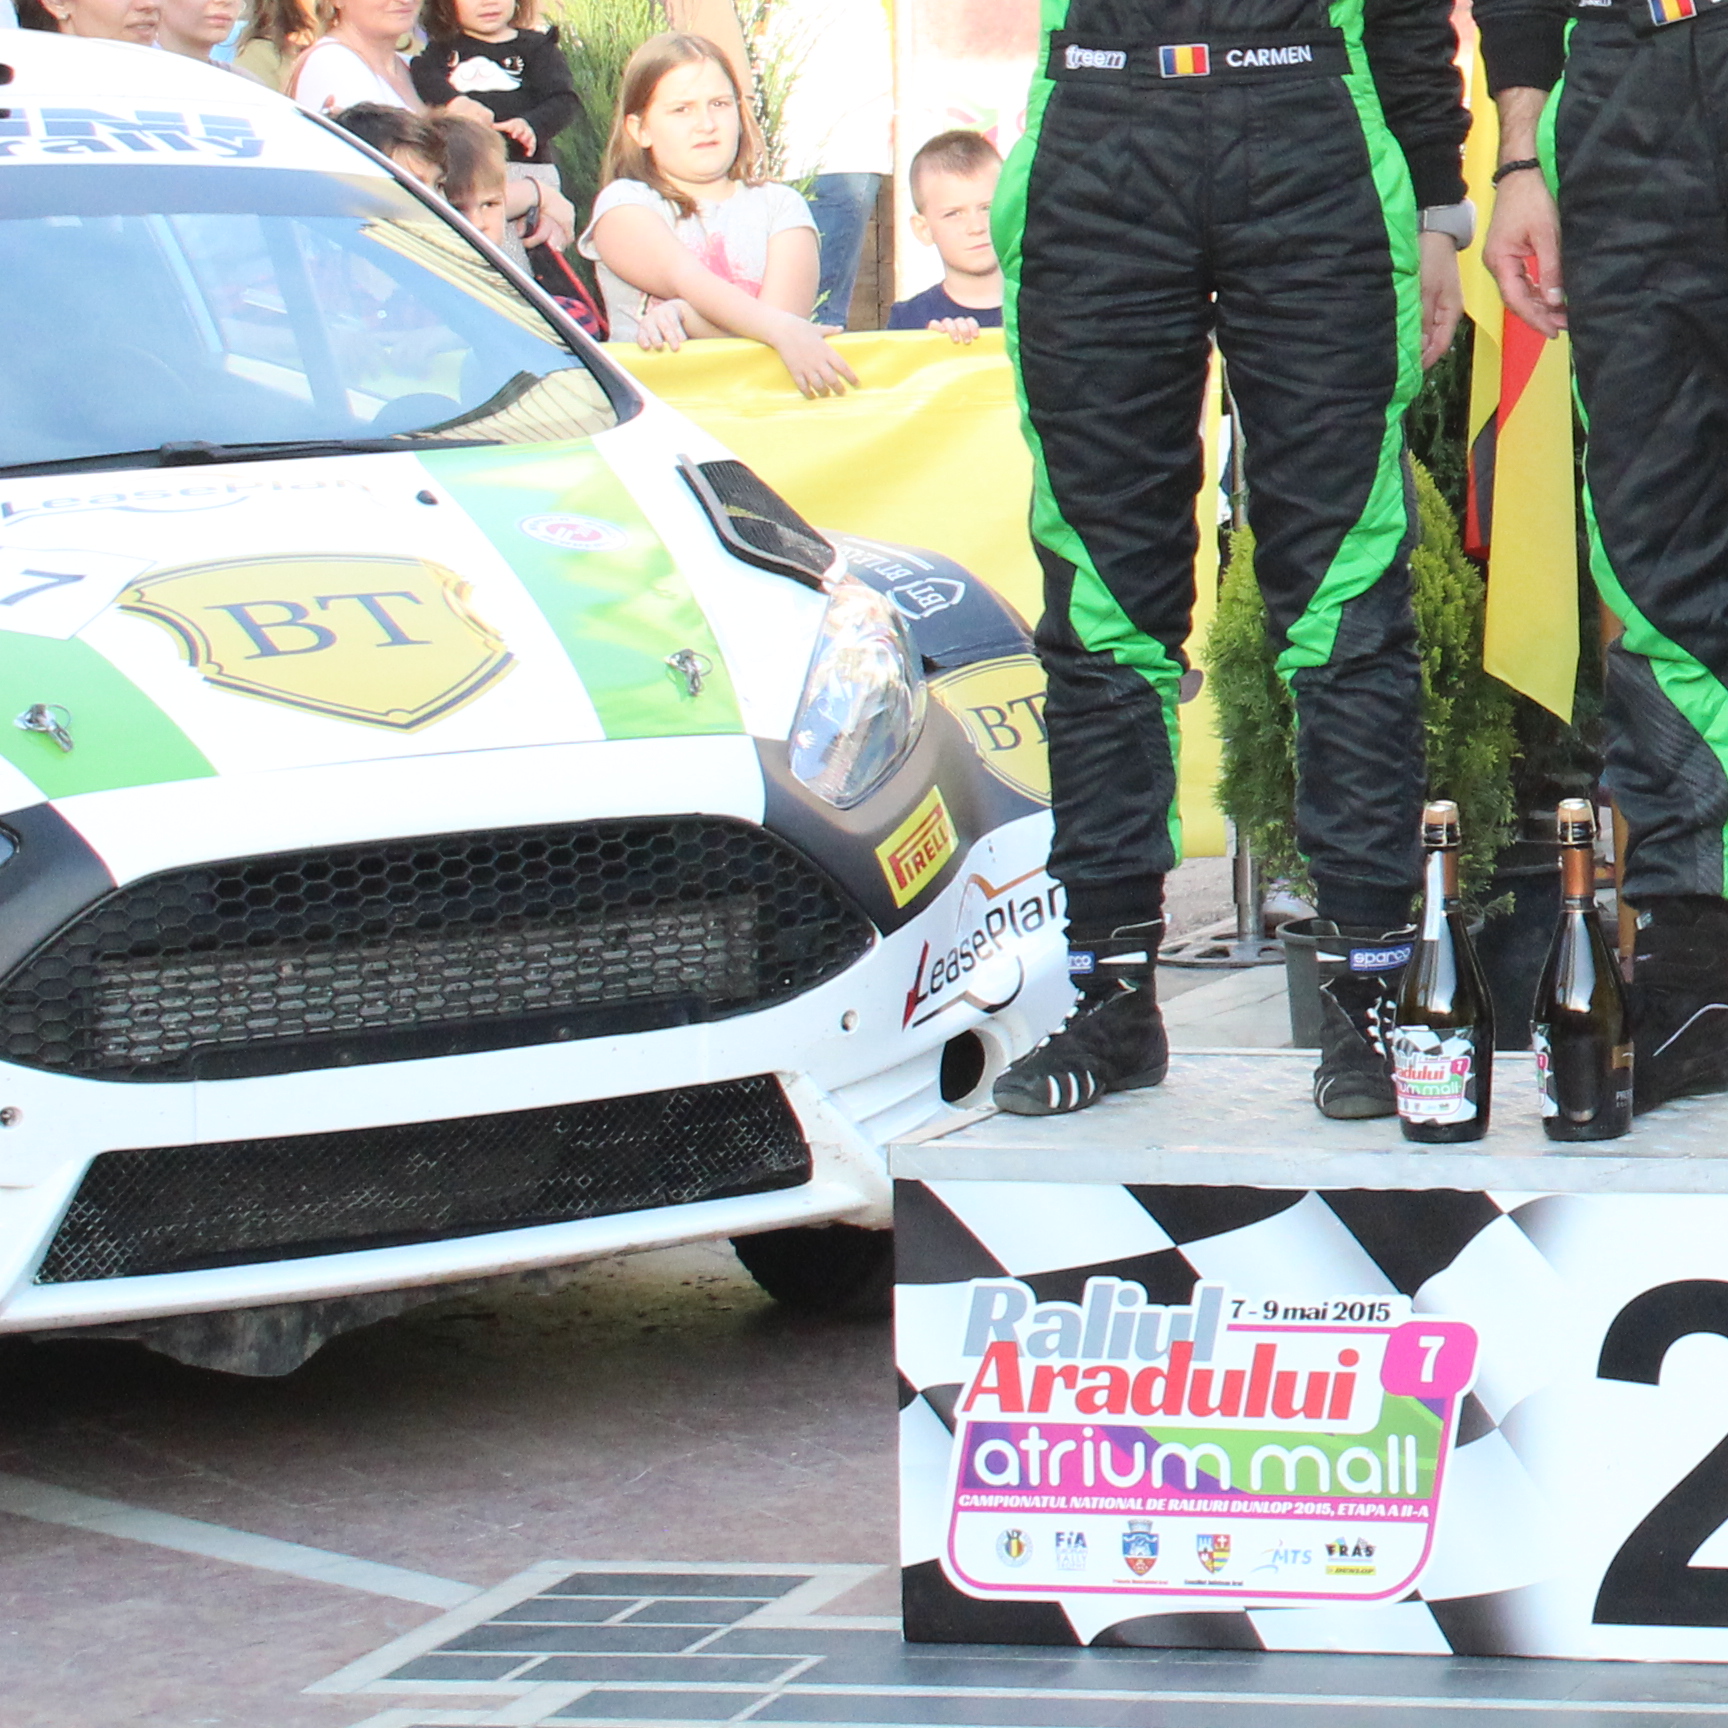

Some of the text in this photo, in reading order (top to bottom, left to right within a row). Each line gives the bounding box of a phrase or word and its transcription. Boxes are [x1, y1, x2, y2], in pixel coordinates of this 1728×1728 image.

[1066, 44, 1312, 69] freem CARMEN
[907, 585, 947, 608] BT
[205, 589, 433, 661] BT
[967, 691, 1049, 754] BT
[1353, 948, 1411, 966] sparco
[962, 1283, 1224, 1361] Raliul
[1231, 1299, 1246, 1320] 7
[1262, 1300, 1279, 1320] 9
[1283, 1301, 1328, 1322] mai
[1333, 1302, 1391, 1323] 2015
[1417, 1335, 1446, 1382] 7
[962, 1340, 1361, 1421] Aradului
[973, 1425, 1418, 1495] atrium mall
[958, 1494, 1068, 1510] CAMPIONATUL
[1069, 1497, 1143, 1511] NATIONAL
[1145, 1499, 1166, 1511] DE
[1167, 1499, 1231, 1514] RALIURI
[1231, 1500, 1291, 1515] DUNLOP
[1337, 1504, 1387, 1517] ETAPA
[1387, 1505, 1399, 1518] A
[1399, 1506, 1430, 1518] II-A
[1273, 1548, 1313, 1565] MTS
[1326, 1542, 1375, 1558] FRAS
